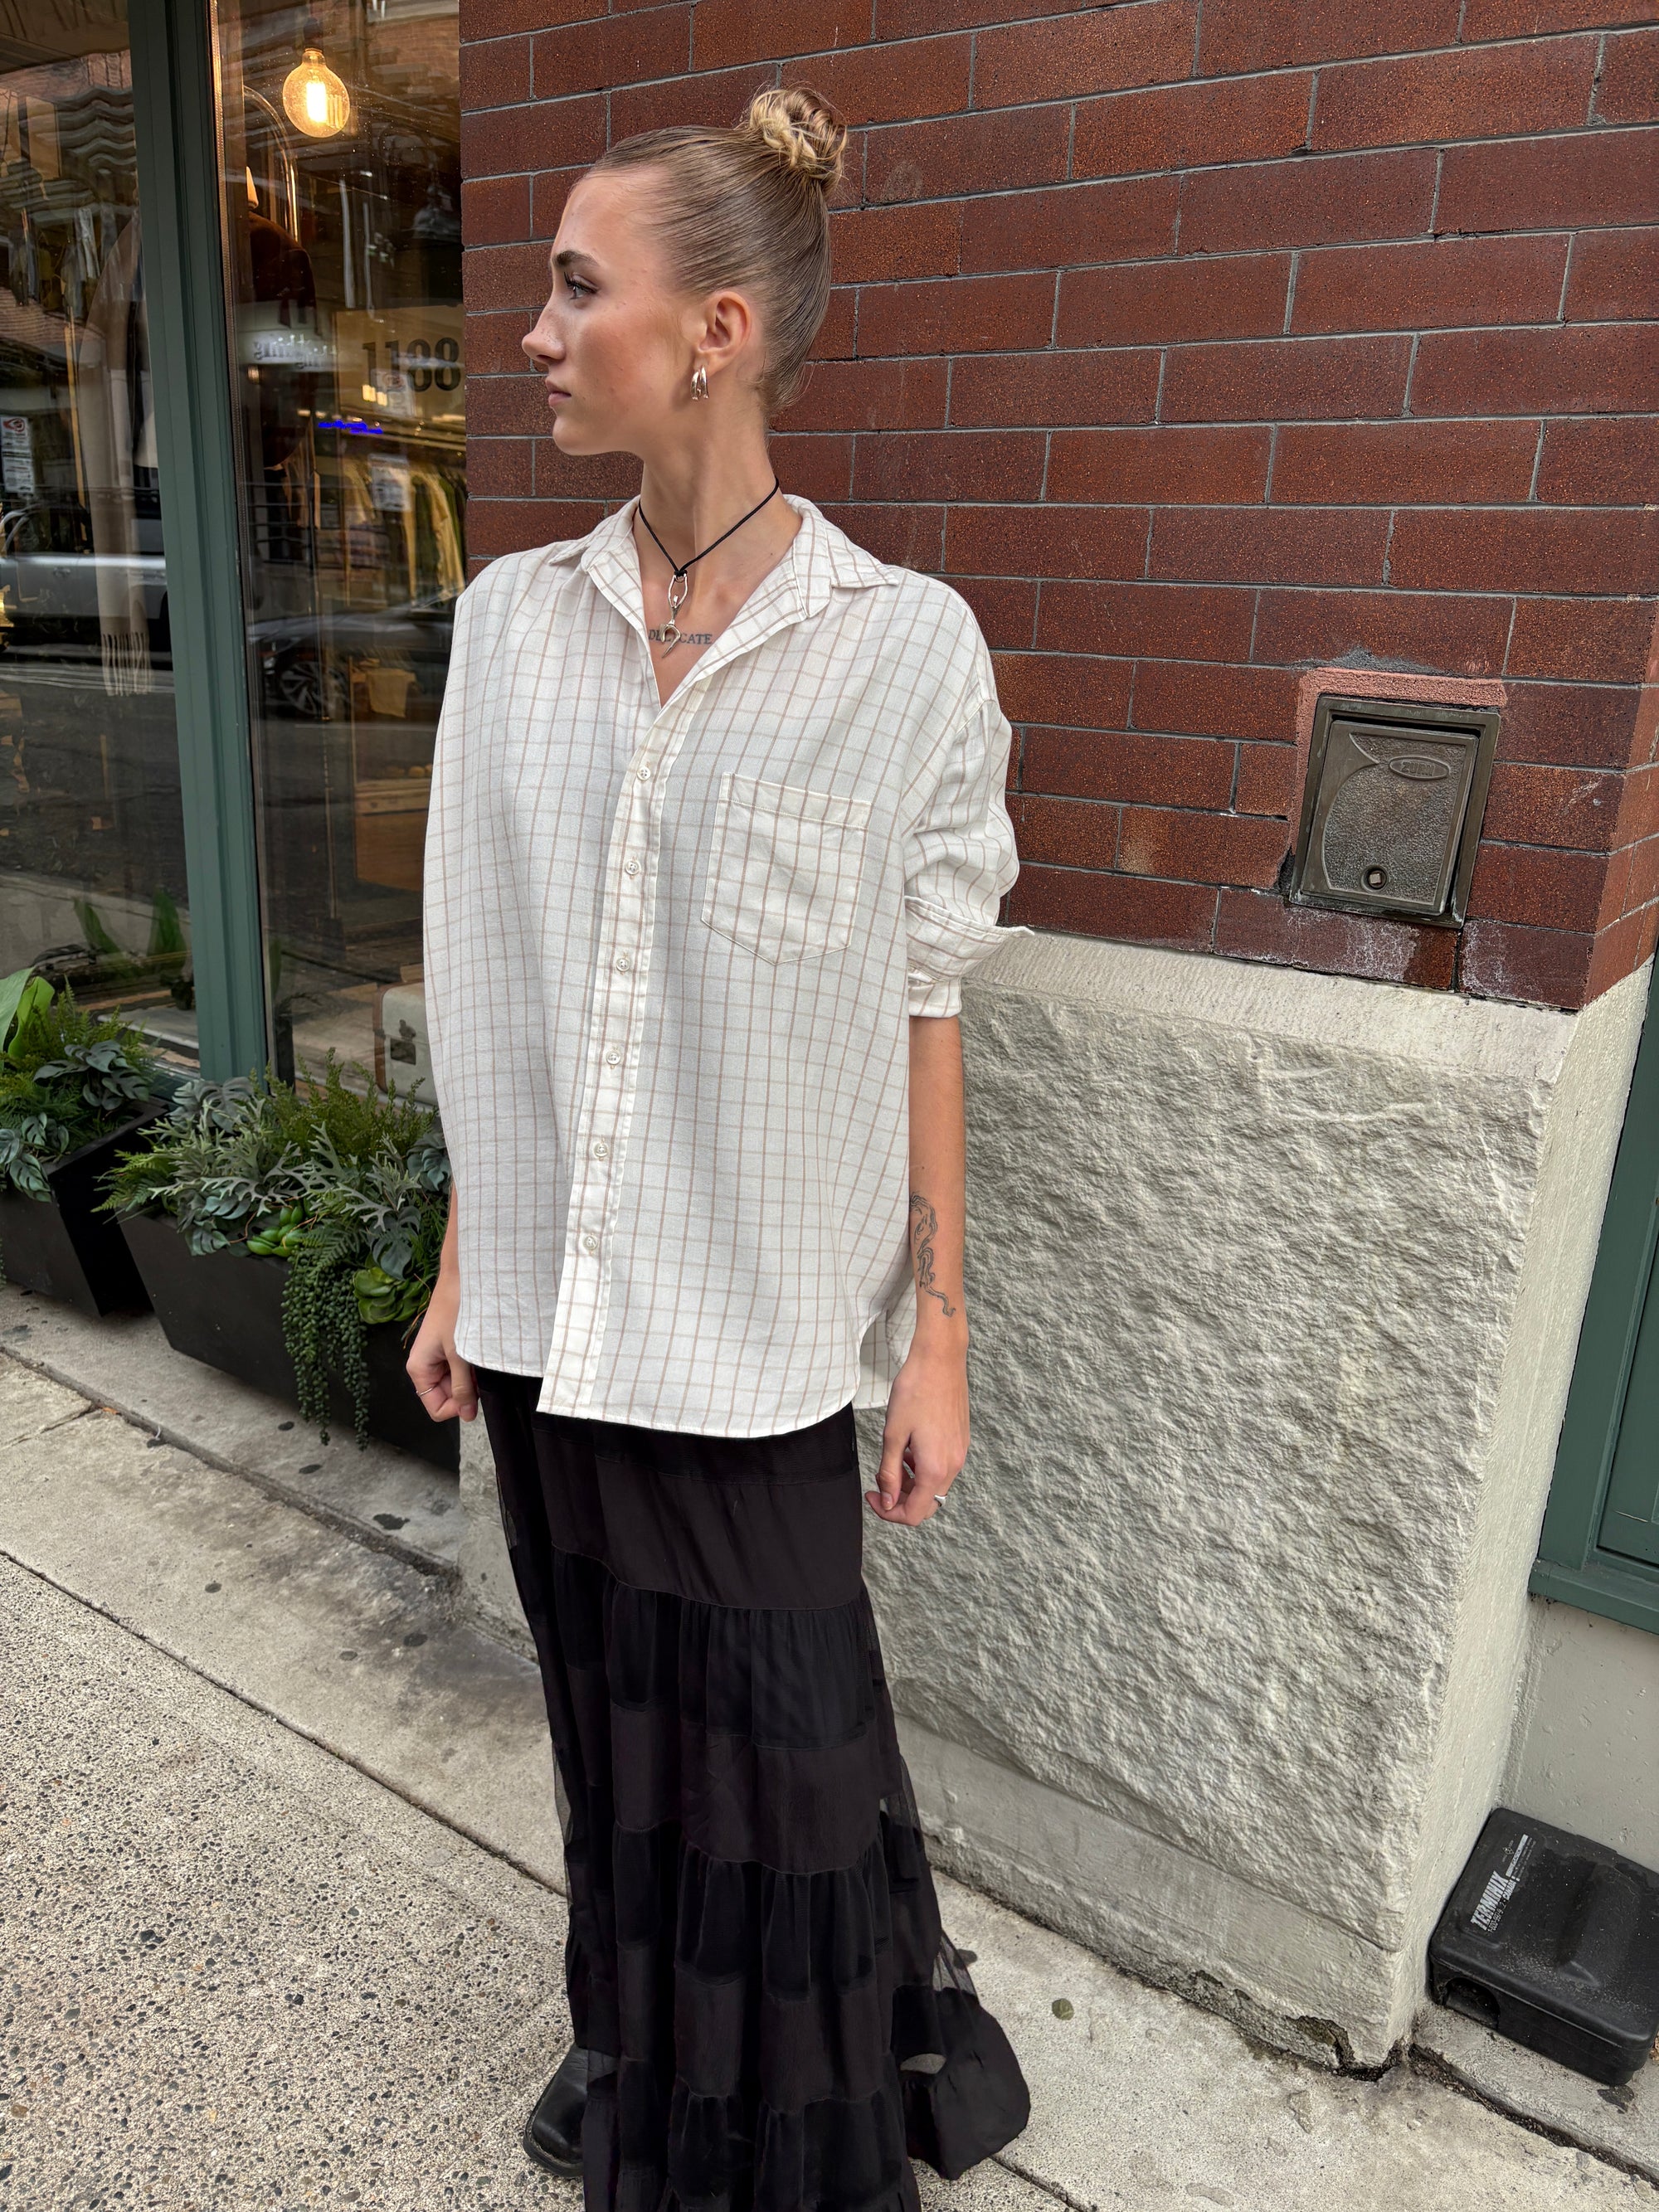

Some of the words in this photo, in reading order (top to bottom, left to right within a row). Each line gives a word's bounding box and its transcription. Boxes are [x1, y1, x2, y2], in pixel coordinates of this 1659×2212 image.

[649, 630, 713, 644] DELCATE
[1400, 761, 1436, 777] ZURN
[1470, 1869, 1510, 1931] TERMINIX
